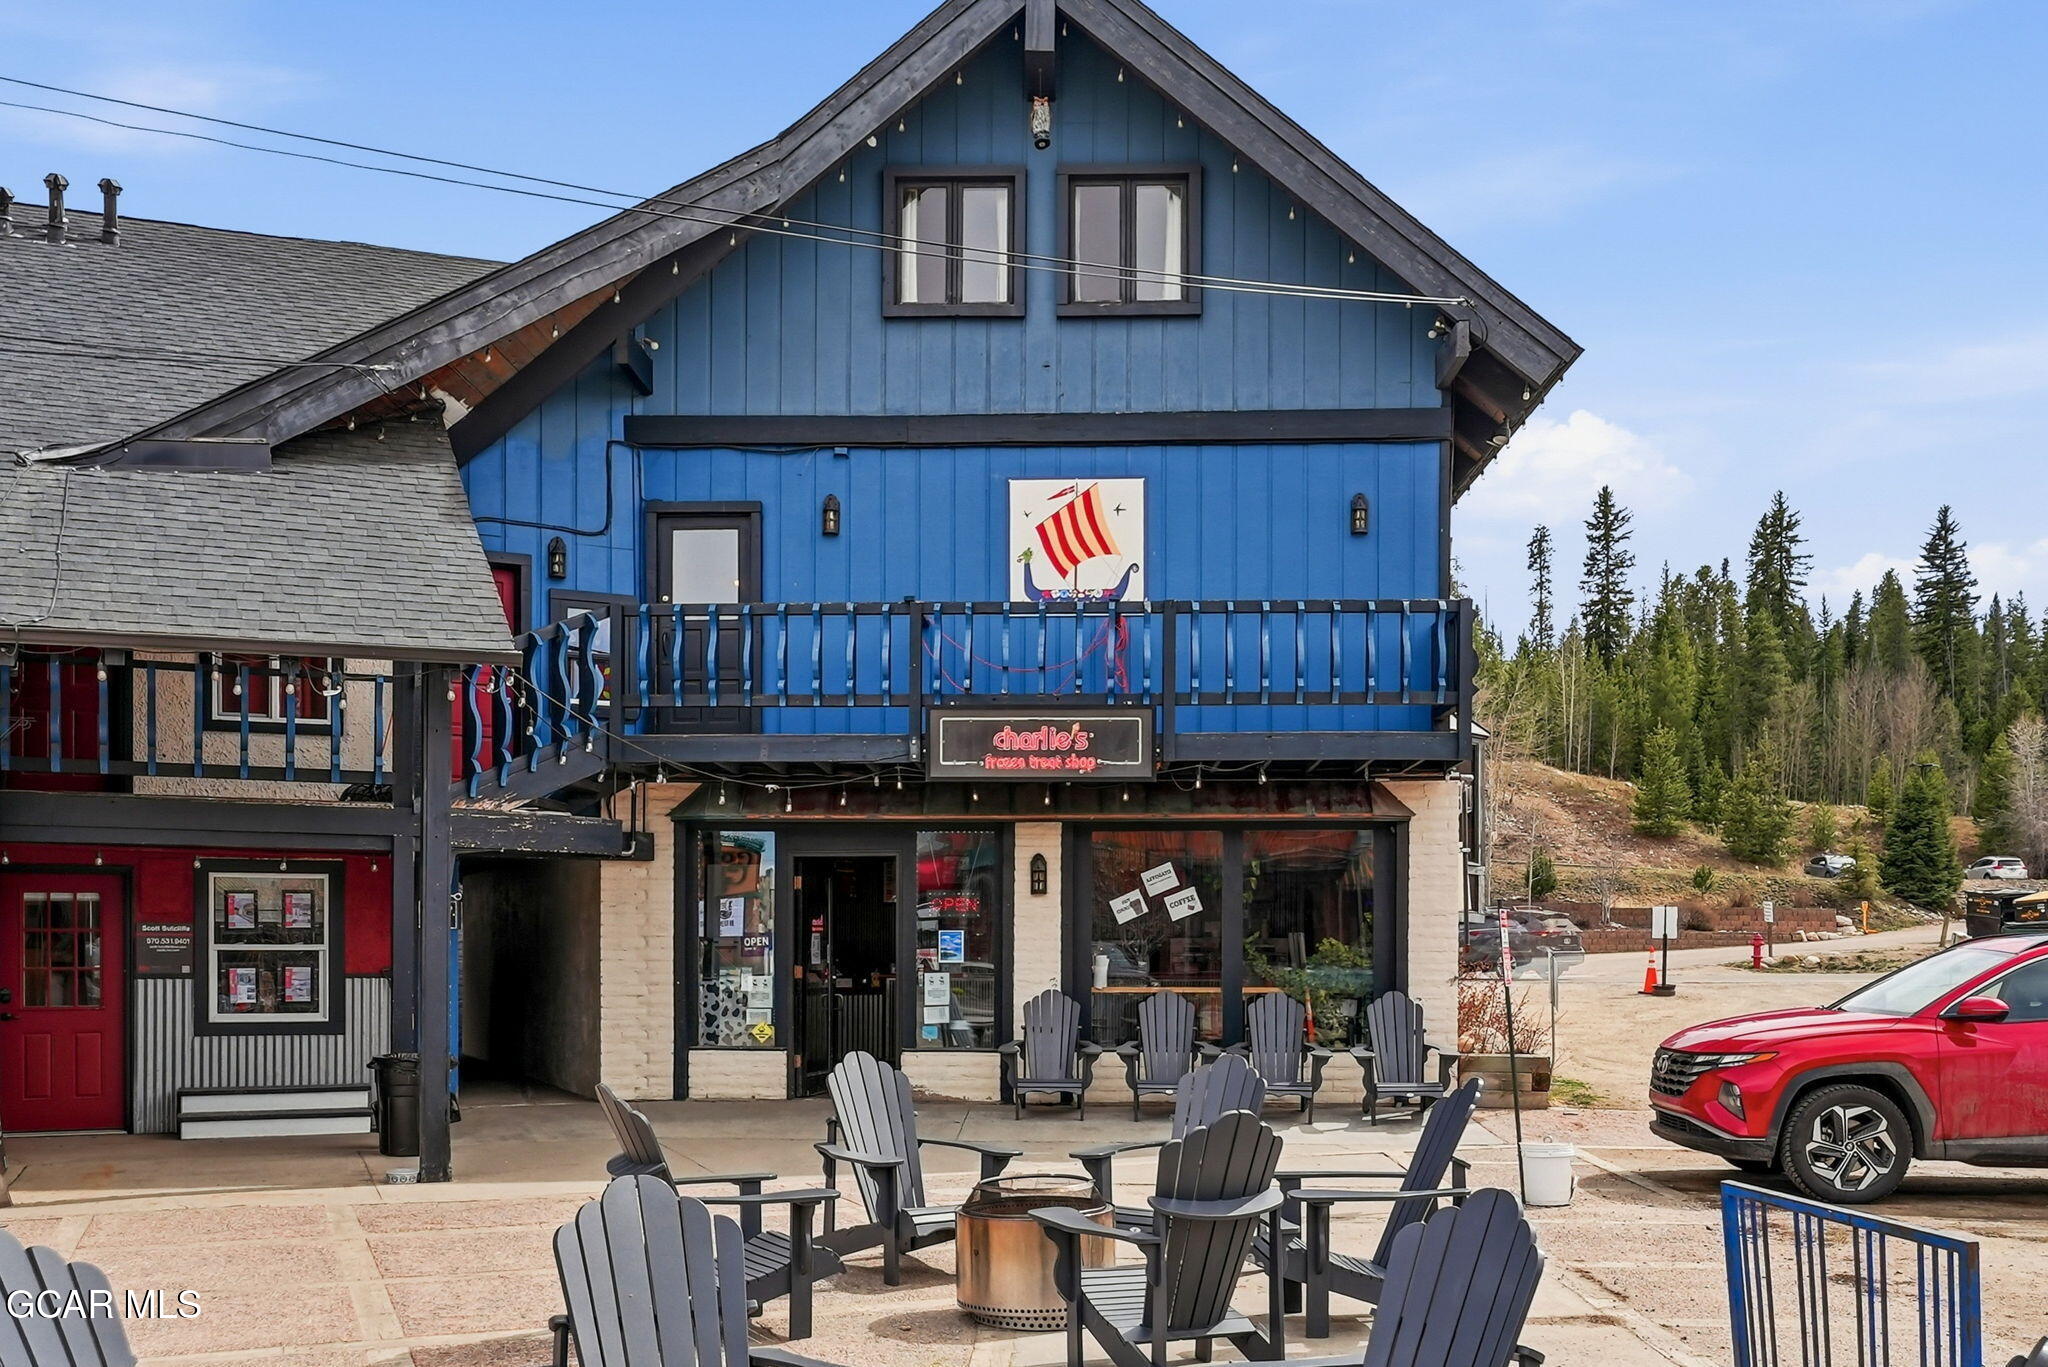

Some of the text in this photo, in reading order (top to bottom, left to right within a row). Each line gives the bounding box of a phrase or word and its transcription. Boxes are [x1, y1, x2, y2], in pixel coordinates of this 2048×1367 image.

[992, 722, 1089, 751] charlie's
[984, 752, 1097, 772] frozen treat shop
[929, 897, 977, 912] OPEN
[1168, 894, 1196, 909] COFFEE
[743, 936, 769, 947] OPEN
